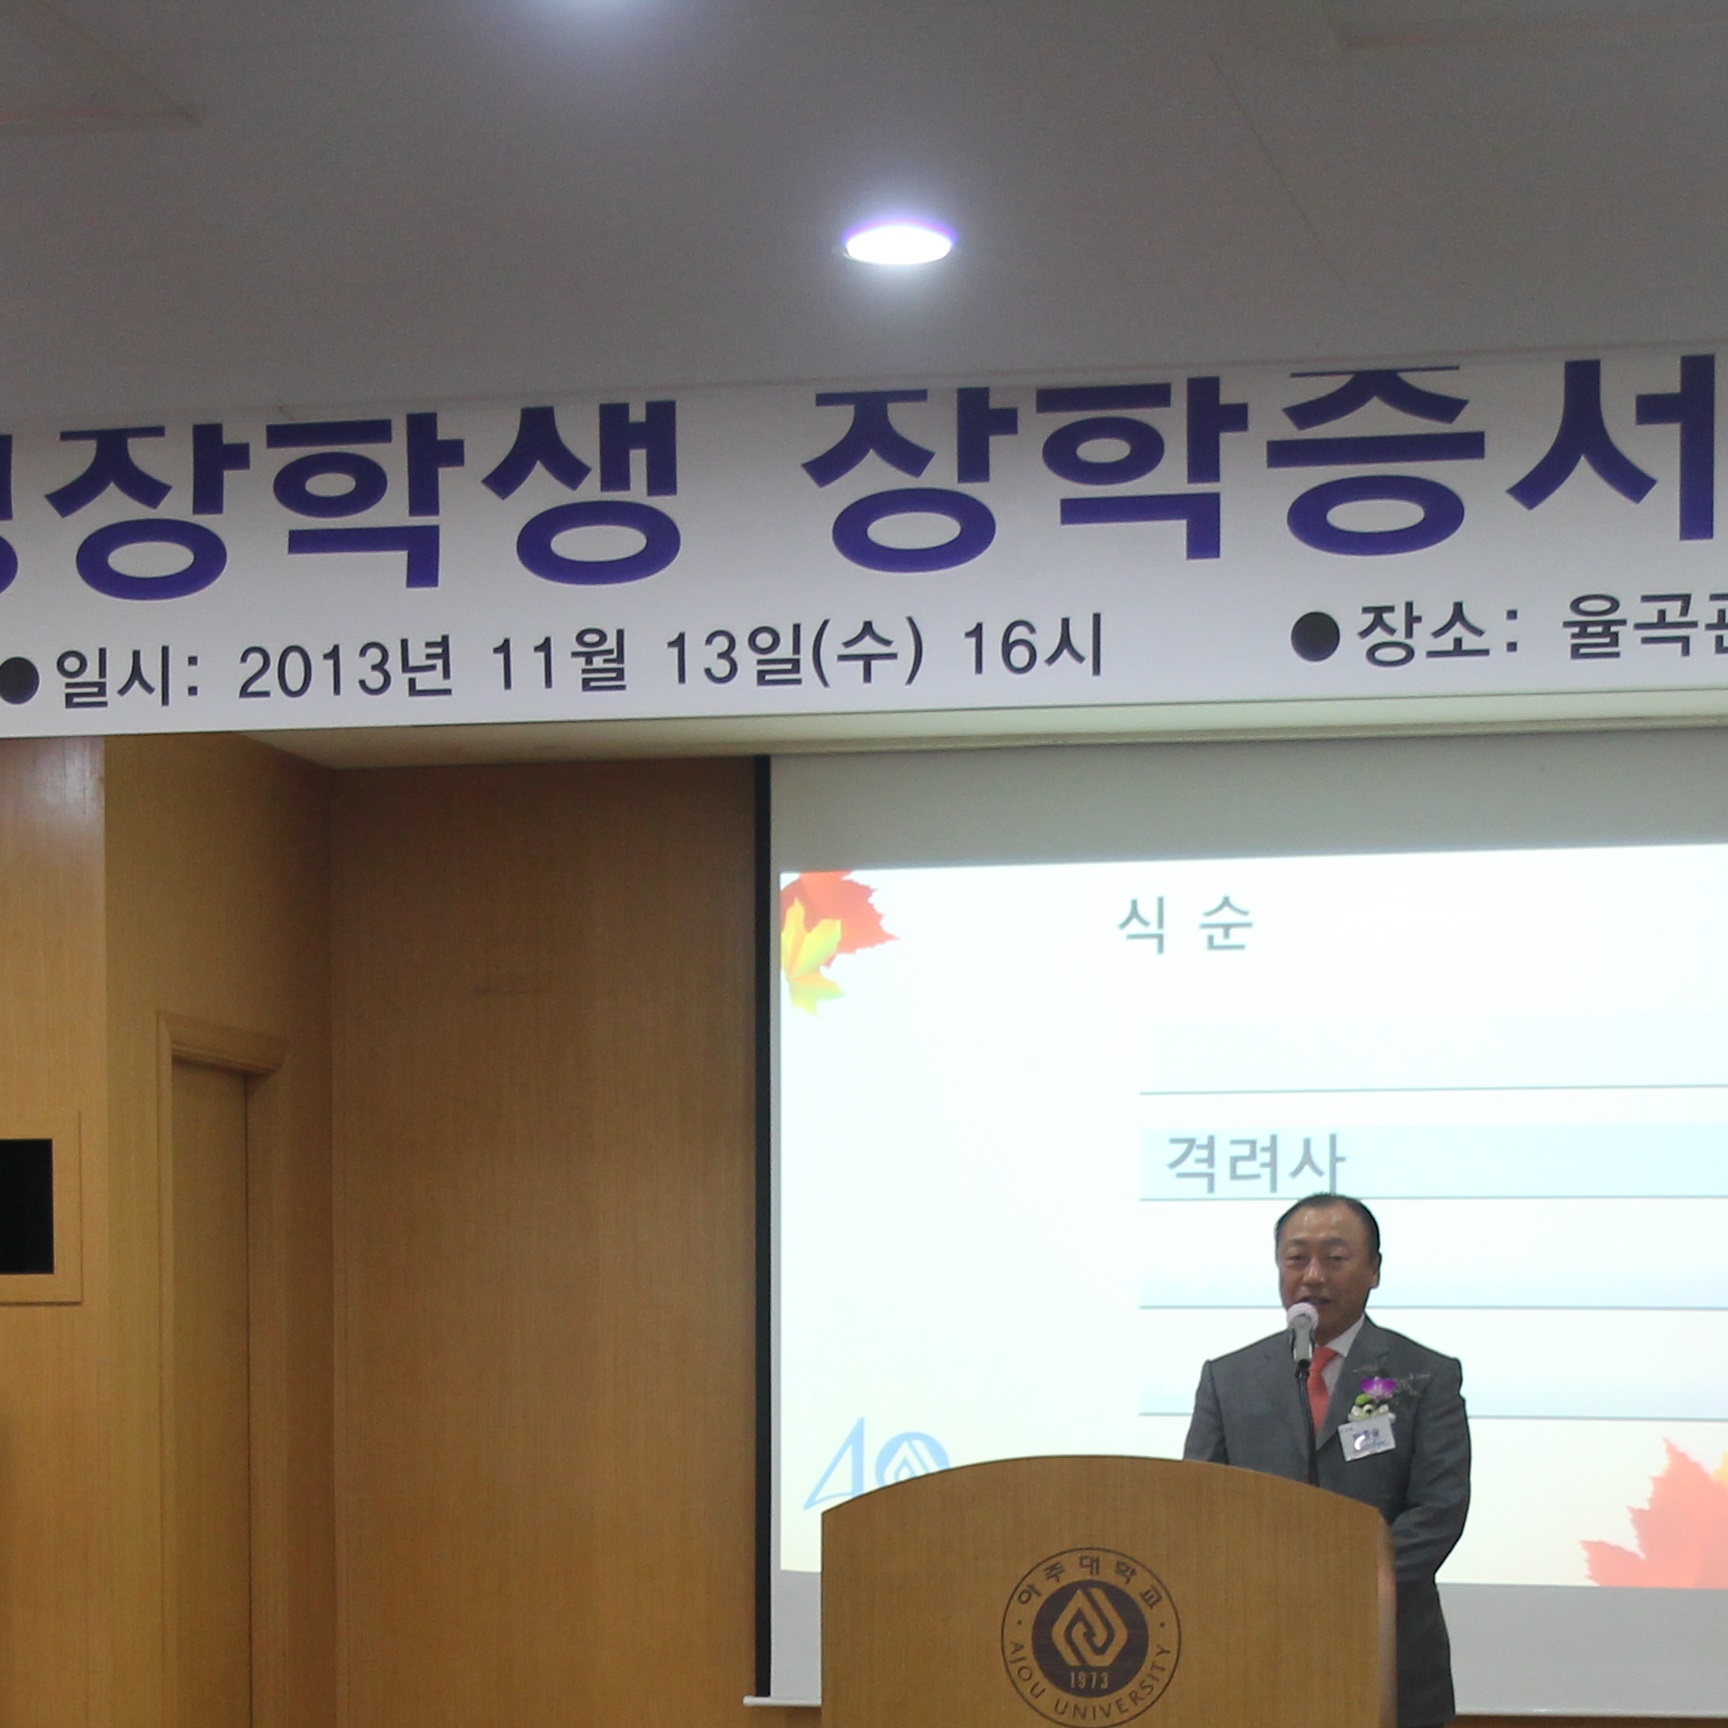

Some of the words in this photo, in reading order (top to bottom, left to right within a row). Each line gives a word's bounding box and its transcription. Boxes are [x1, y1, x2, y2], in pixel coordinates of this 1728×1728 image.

[800, 353, 1716, 574] 장학증서
[55, 643, 199, 710] 일시:
[237, 633, 454, 700] 2013년
[491, 626, 628, 693] 11월
[666, 615, 925, 689] 13일(수)
[963, 611, 1104, 678] 16시
[1356, 599, 1520, 668] 장소:
[1117, 895, 1166, 956] 식
[1198, 894, 1254, 952] 순
[1166, 1132, 1348, 1197] 격려사
[1017, 1555, 1163, 1610] 아주대학교
[1008, 1640, 1047, 1700] AJOU
[1053, 1643, 1171, 1721] UNIVERSITY
[1069, 1671, 1109, 1689] 1973
